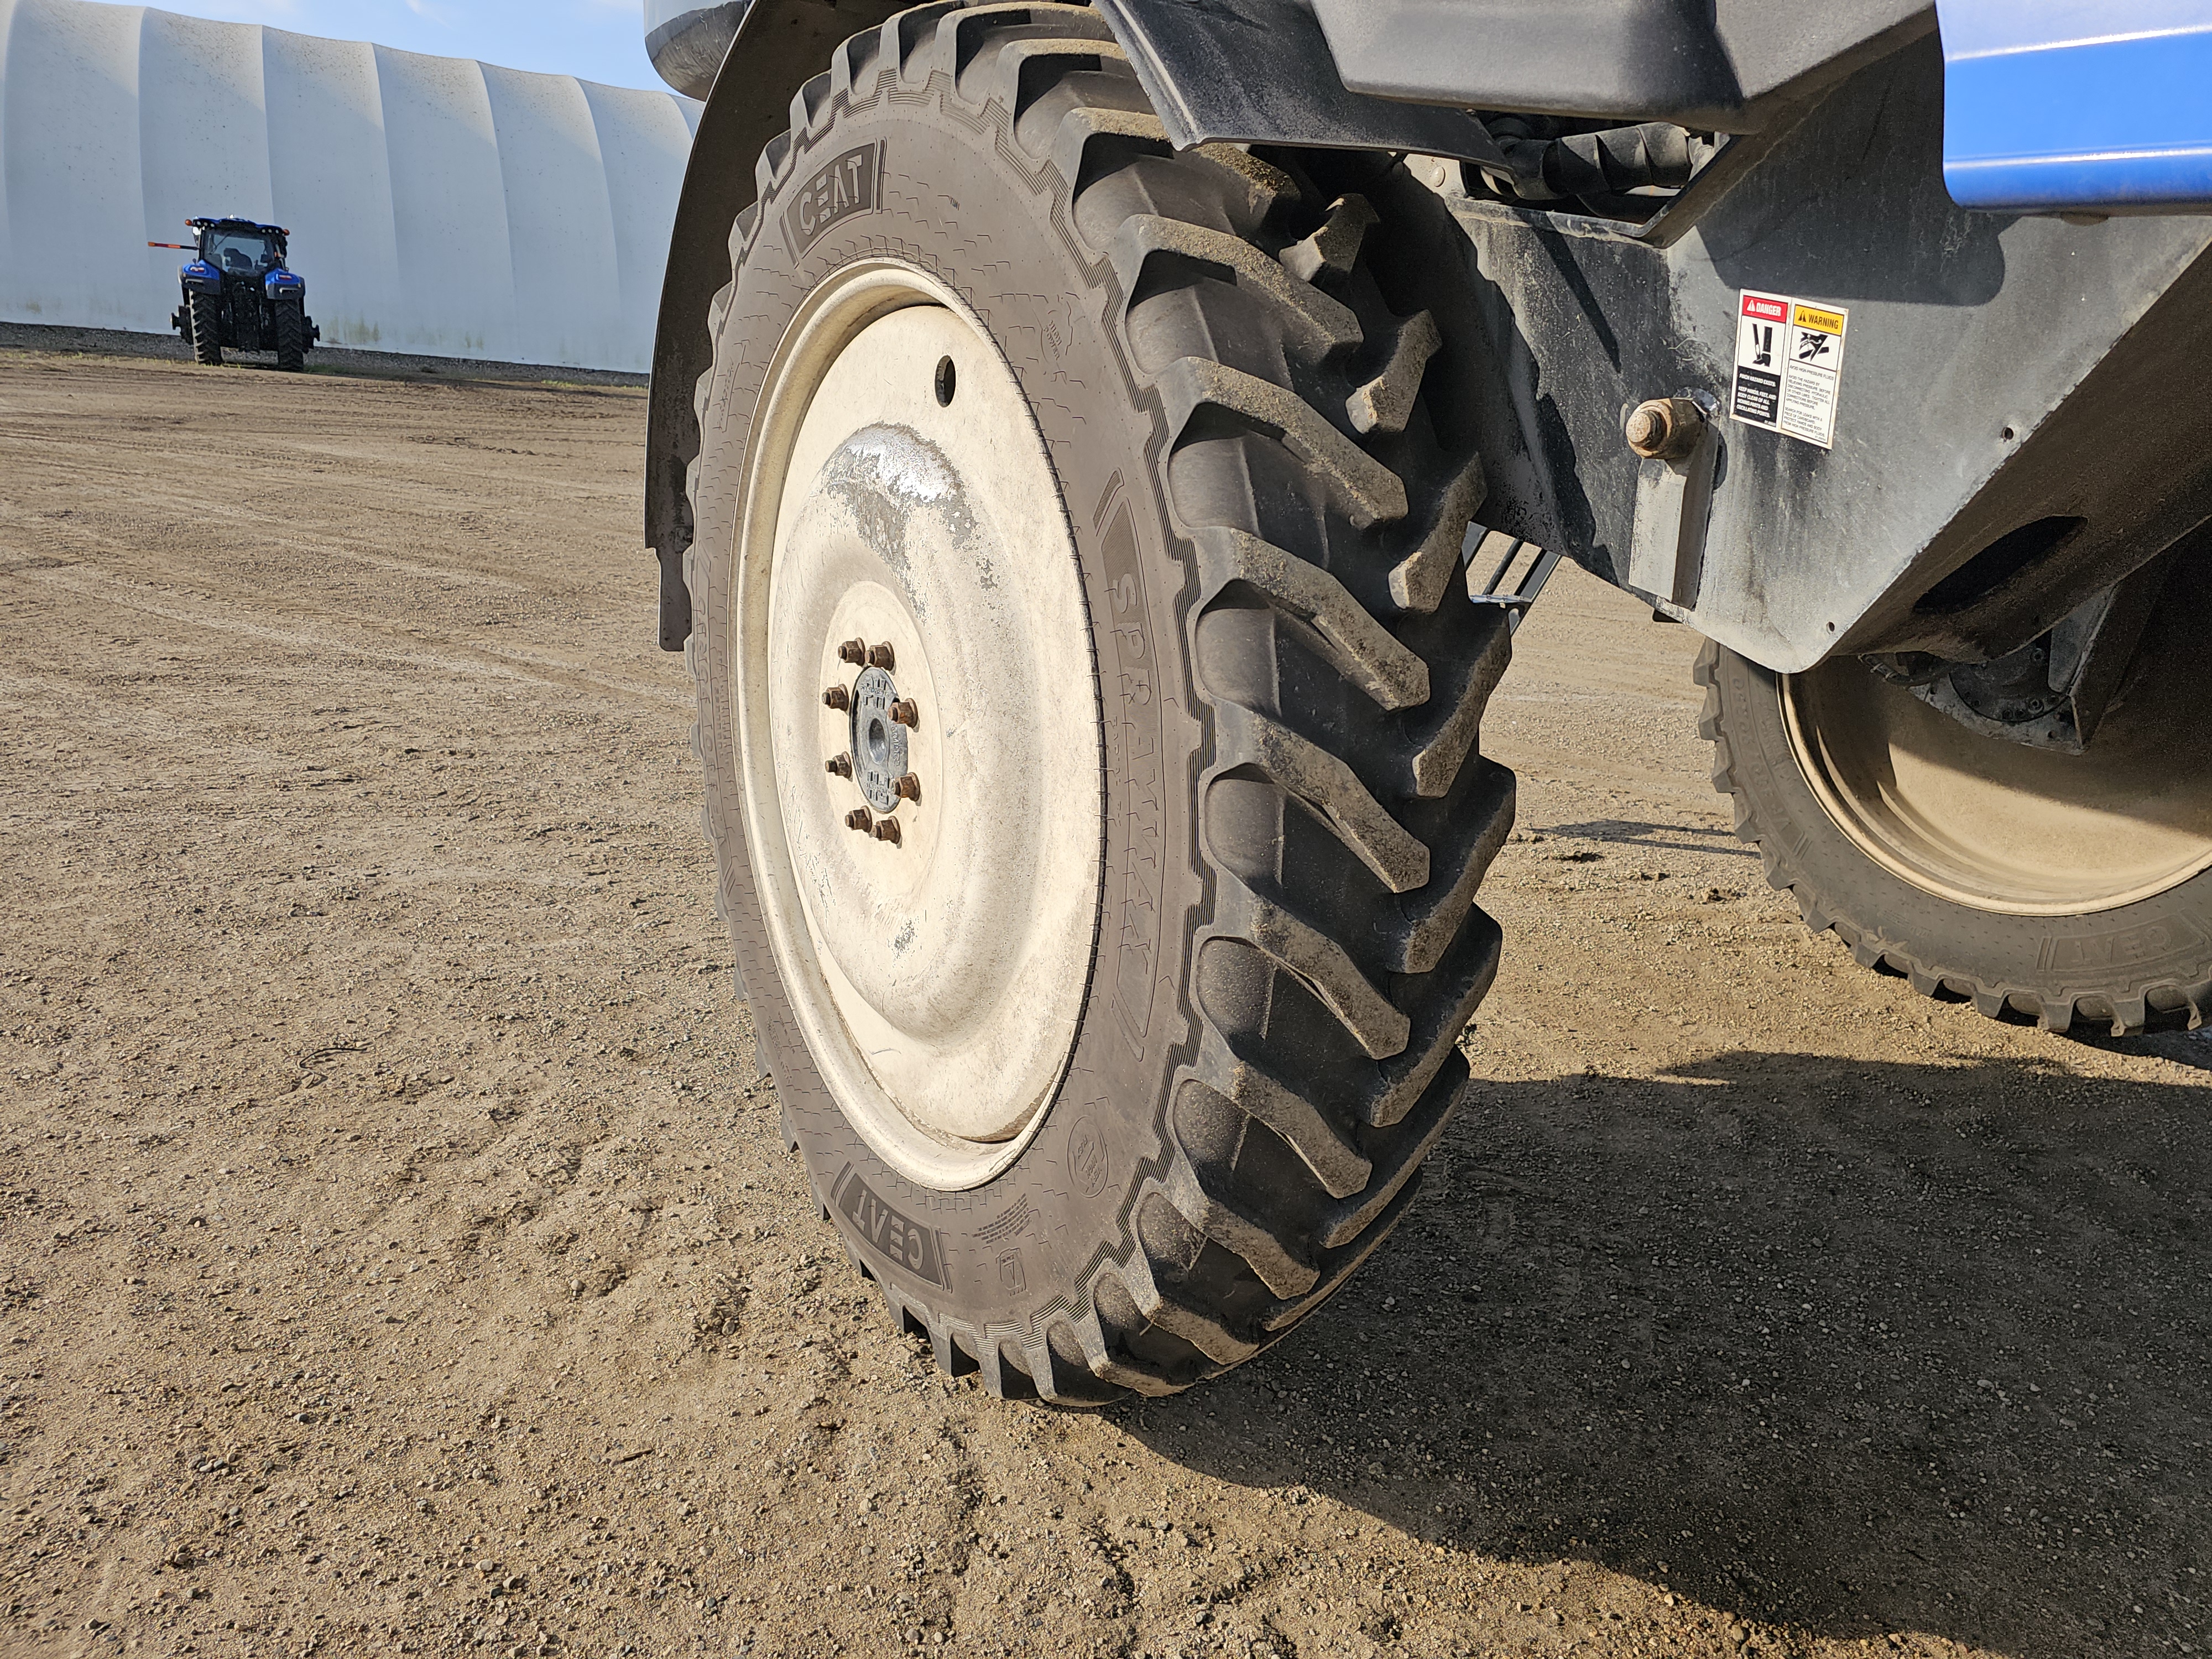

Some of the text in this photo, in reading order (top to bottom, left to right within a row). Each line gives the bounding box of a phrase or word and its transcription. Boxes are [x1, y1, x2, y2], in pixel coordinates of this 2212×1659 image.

[799, 154, 863, 236] CEAT
[1756, 302, 1782, 316] DANGER
[1808, 314, 1839, 329] WARNING
[2071, 926, 2172, 965] CEAT
[852, 1188, 925, 1271] CEAT
